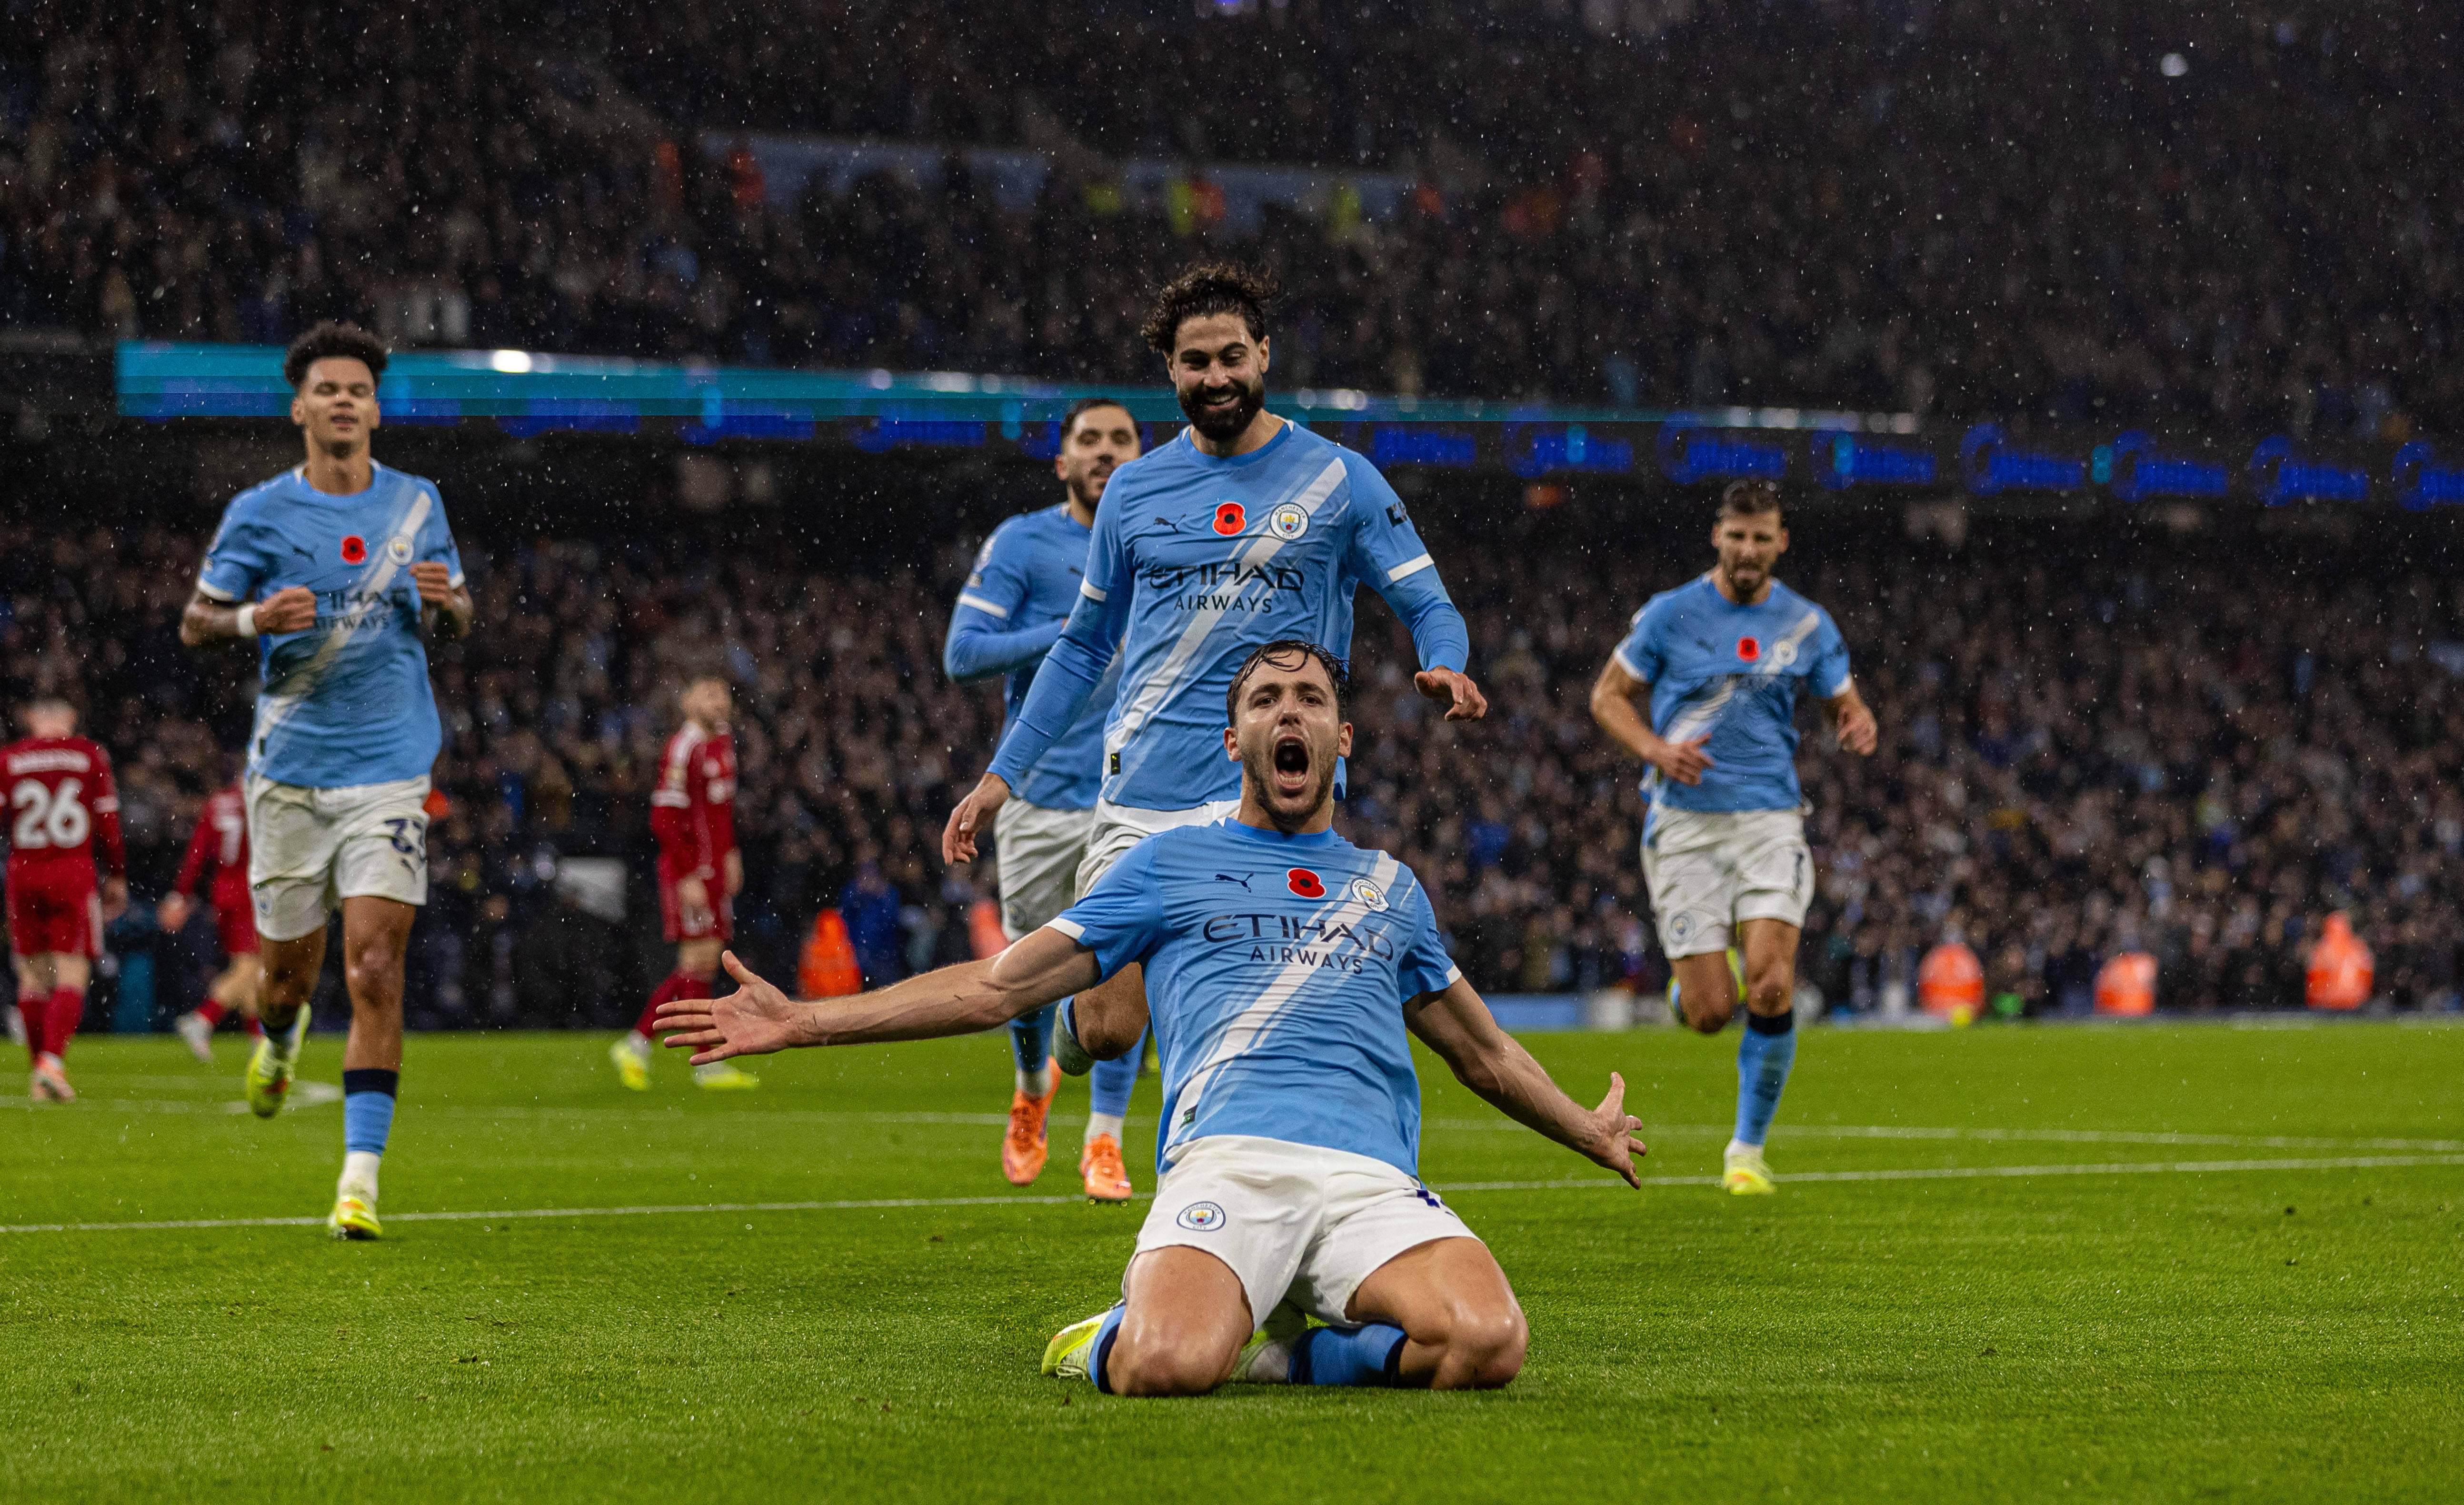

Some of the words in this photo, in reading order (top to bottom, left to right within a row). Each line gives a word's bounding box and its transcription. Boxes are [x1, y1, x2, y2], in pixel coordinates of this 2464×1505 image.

[1149, 563, 1305, 590] ETIHAD
[1174, 595, 1272, 613] AIRWAYS
[11, 777, 90, 849] 26
[1203, 913, 1394, 962] ETIHAD
[1250, 946, 1363, 975] AIRWAYS
